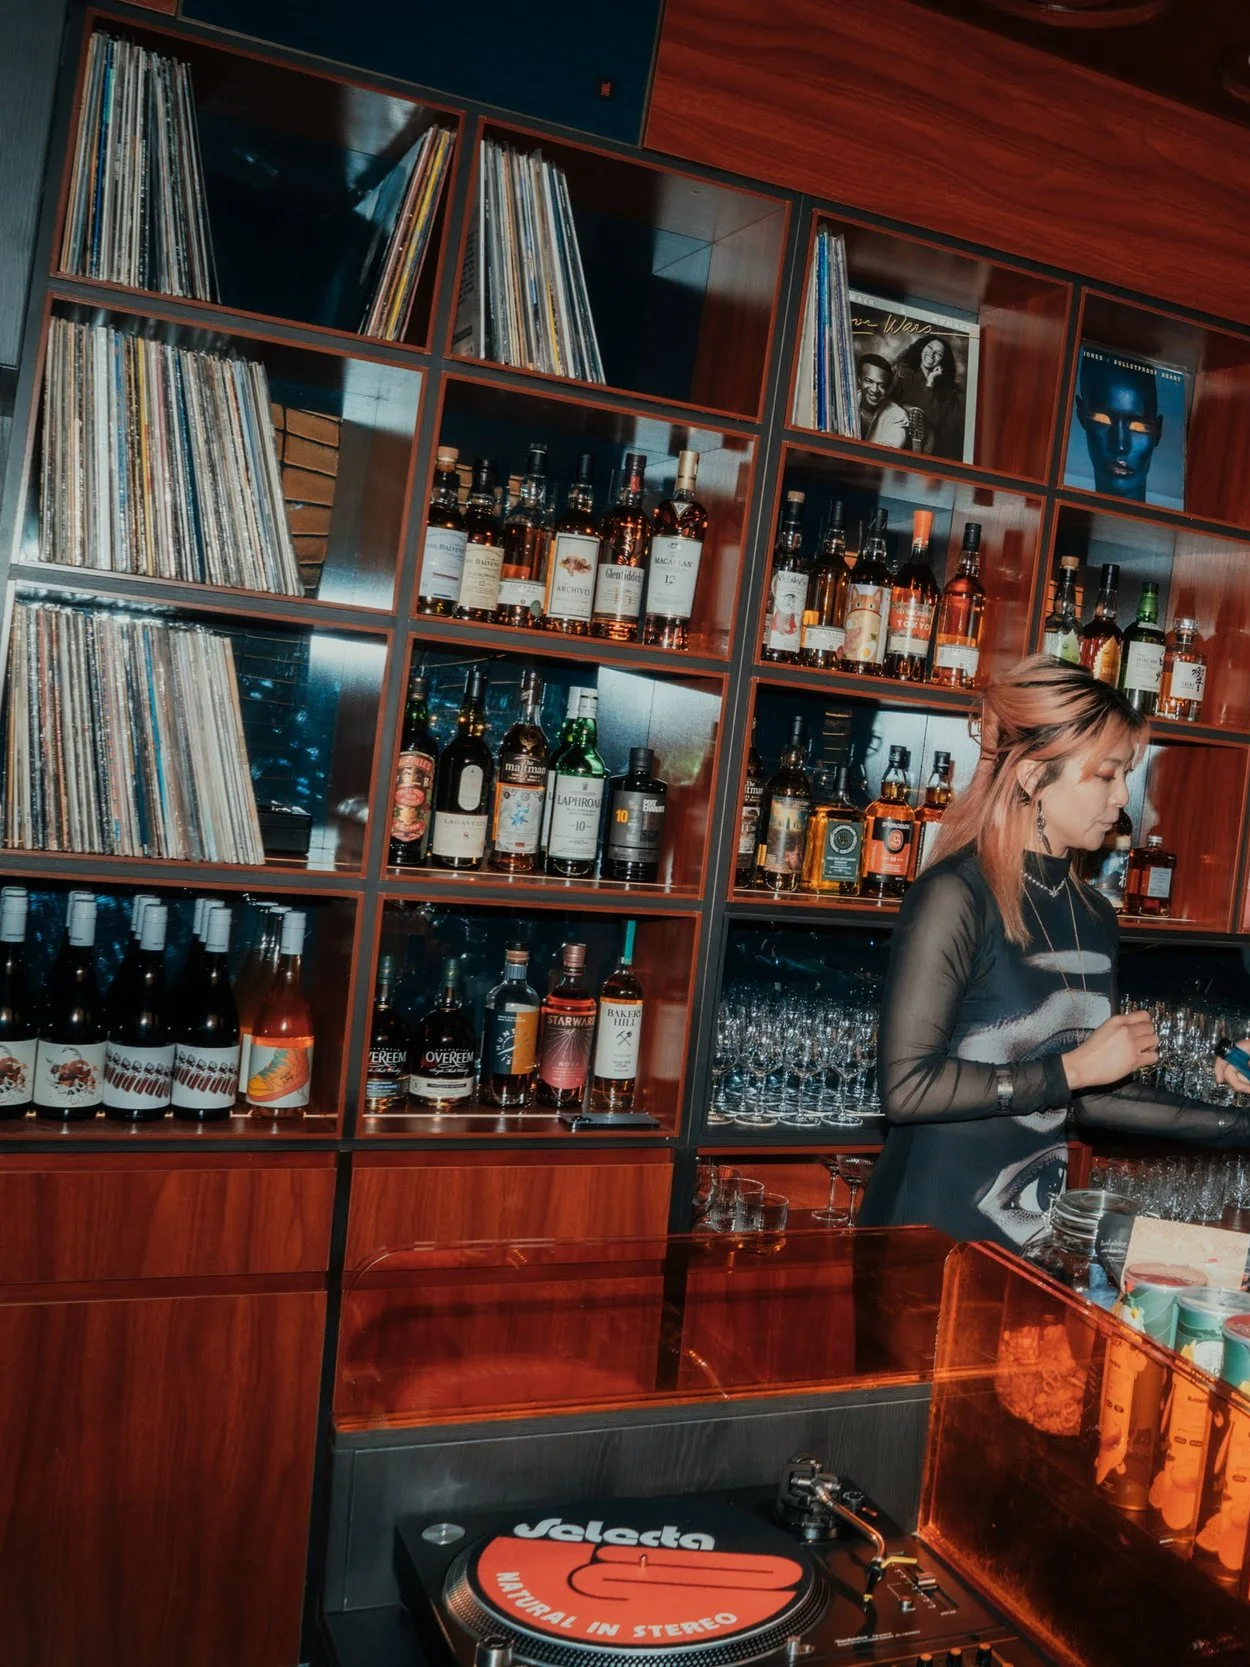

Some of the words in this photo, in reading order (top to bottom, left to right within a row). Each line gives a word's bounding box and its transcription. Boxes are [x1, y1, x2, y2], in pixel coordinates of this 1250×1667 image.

[849, 293, 875, 306] MACK
[884, 314, 932, 335] Wars
[1083, 350, 1103, 361] JONES
[1113, 359, 1158, 376] BULLETPROOF
[1161, 371, 1182, 383] HEART
[654, 557, 694, 569] MACAAN
[663, 574, 677, 585] 12
[556, 584, 592, 596] ARCHIVES
[504, 762, 546, 775] maltman
[557, 794, 600, 808] LAPHROA
[615, 808, 629, 823] 10
[575, 820, 586, 832] 10
[613, 1018, 637, 1027] HILL
[368, 1050, 408, 1065] VEREEM
[425, 1050, 474, 1066] OVEREEM
[513, 1517, 716, 1551] Selecta
[496, 1571, 577, 1629] NATURAL
[586, 1620, 620, 1637] IN
[633, 1612, 738, 1638] STEREO
